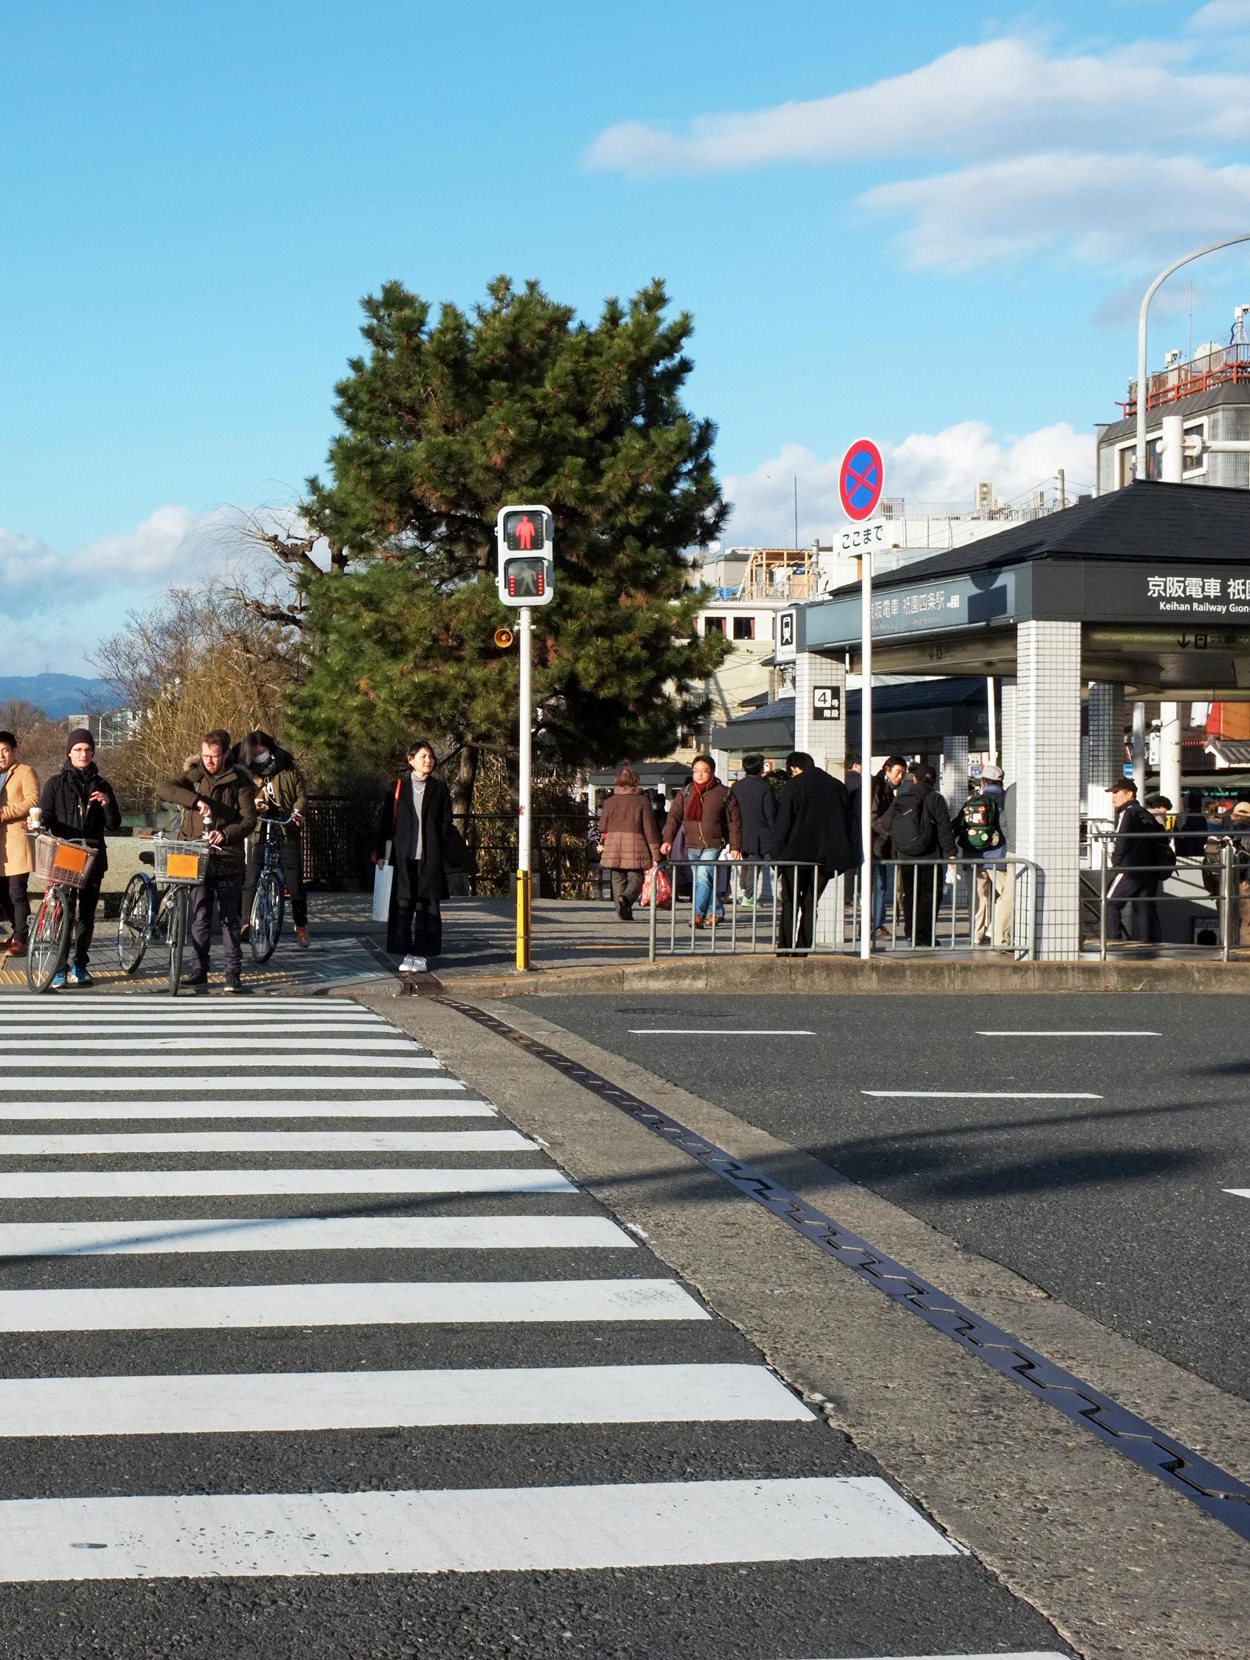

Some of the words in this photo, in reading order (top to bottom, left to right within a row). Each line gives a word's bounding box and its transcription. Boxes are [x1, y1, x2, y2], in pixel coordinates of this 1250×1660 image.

[842, 525, 883, 549] ここまで
[1147, 576, 1221, 599] 京阪電車
[1227, 578, 1250, 600] 祇
[903, 590, 945, 615] 祇園四条駅
[1159, 601, 1190, 611] Keihan
[1192, 602, 1227, 614] Railway
